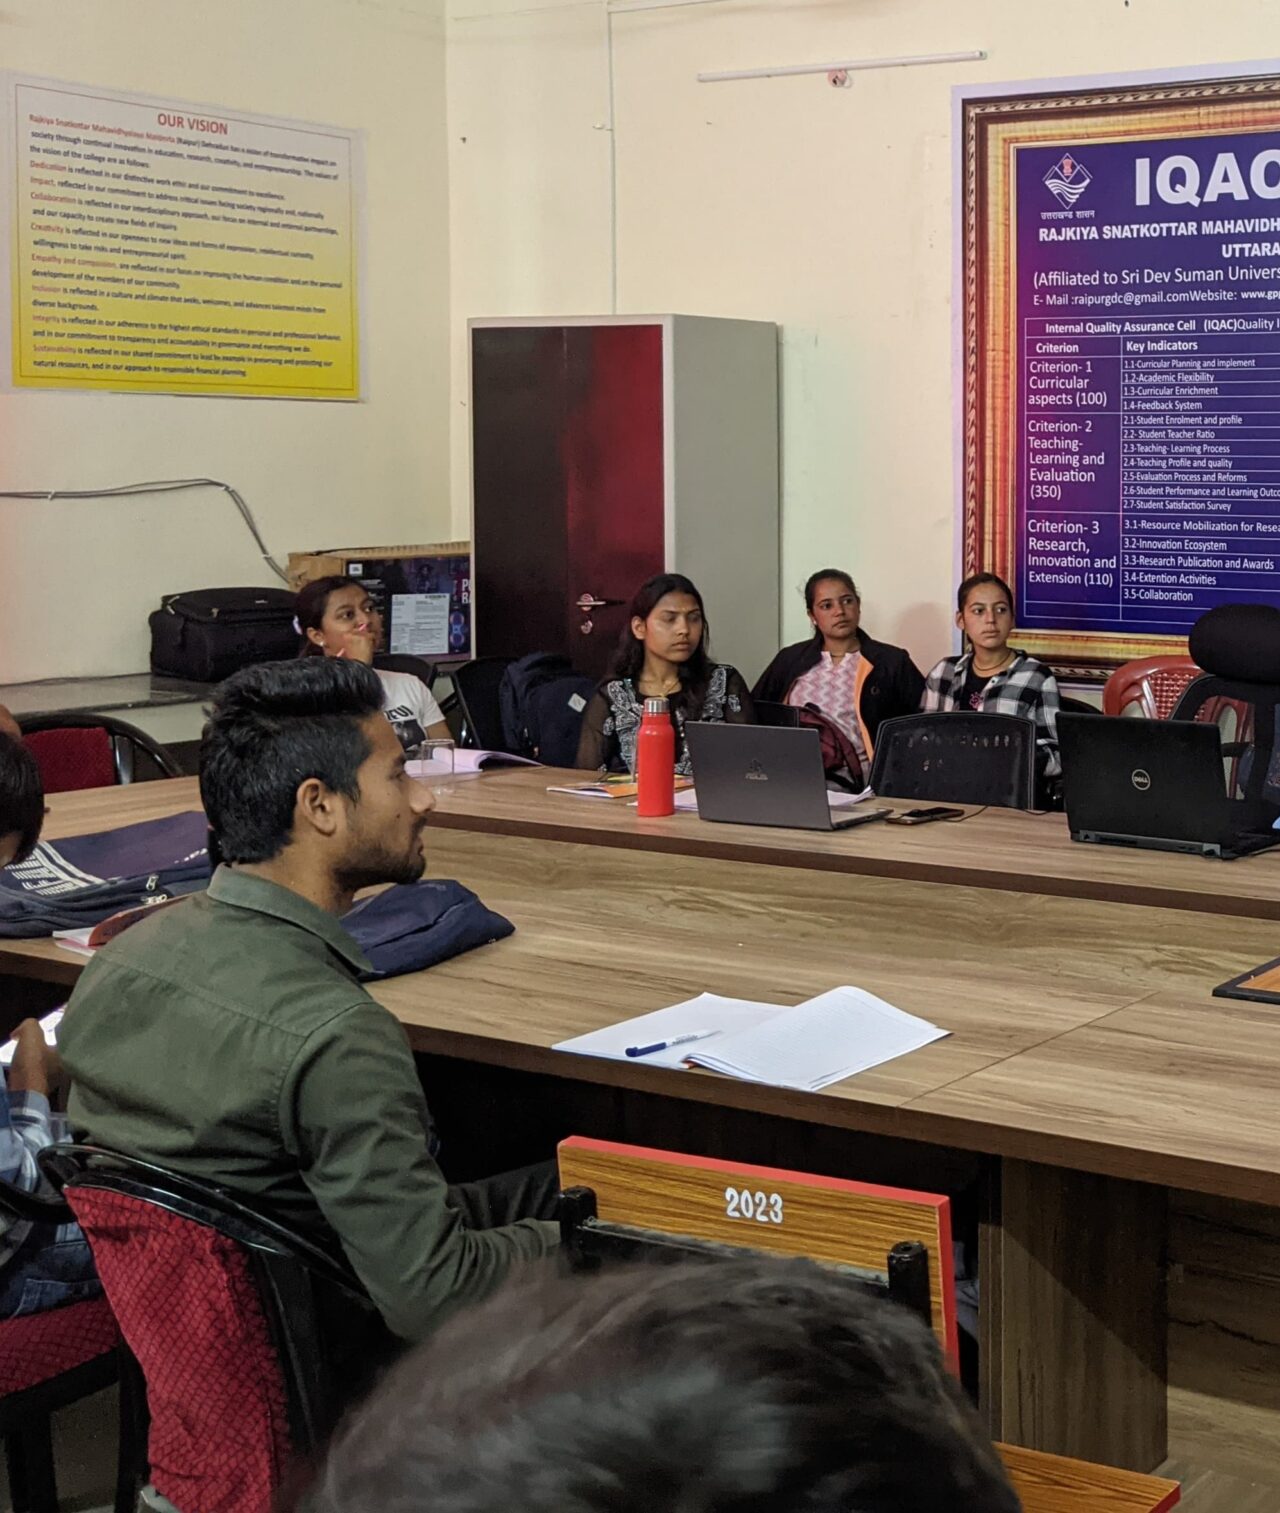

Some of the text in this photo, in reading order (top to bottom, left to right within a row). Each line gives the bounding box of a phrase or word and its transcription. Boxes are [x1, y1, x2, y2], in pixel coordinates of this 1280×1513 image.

[157, 113, 185, 131] OUR
[187, 117, 229, 135] VISION
[1039, 226, 1099, 242] RAJKIYA
[1102, 222, 1198, 239] SNATKOTTAR
[1034, 270, 1099, 291] (Affiliated
[1103, 271, 1117, 285] to
[1121, 269, 1140, 285] Sri
[1144, 269, 1170, 284] Dev
[1175, 266, 1224, 282] Suman
[1046, 294, 1068, 305] Mail
[1046, 322, 1084, 334] Internal
[1085, 320, 1122, 334] Quality
[1124, 320, 1175, 332] Assurance
[1177, 320, 1196, 331] Cell
[1036, 342, 1079, 353] Criterion
[1127, 341, 1145, 353] Key
[1147, 340, 1198, 351] Indicators
[1030, 361, 1092, 373] Criterion- 1
[1124, 360, 1170, 368] 1.1-Curricular
[1172, 359, 1200, 369] Planning
[1202, 359, 1216, 368] and
[1029, 376, 1089, 389] Curricular
[1124, 372, 1214, 382] 1.2-Academic Flexibility
[1124, 386, 1218, 395] 1.3-Curricular Enrichment
[1028, 392, 1107, 407] aspects (100)
[1124, 401, 1202, 411] 1.4-Feedback System
[1028, 420, 1092, 432] Criterion- 2
[1028, 437, 1083, 451] Teaching-
[1030, 452, 1105, 466] Learning and
[1030, 469, 1095, 482] Evaluation
[1030, 484, 1062, 500] (350)
[1028, 520, 1100, 534] Criterion- 3
[1124, 520, 1181, 530] 3.1-Resource
[1183, 521, 1238, 531] Mobilization
[1240, 522, 1254, 532] for
[1029, 538, 1090, 553] Research,
[1124, 538, 1227, 552] 3.2-Innovation Ecosystem
[1028, 555, 1116, 568] Innovation and
[1124, 555, 1274, 570] 3.3-Research Publication and Awards
[1029, 571, 1113, 588] Extension (110)
[1124, 572, 1216, 585] 3.4-Extention Activities
[1124, 589, 1193, 601] 3.5-Collaboration
[724, 1187, 784, 1224] 2023
